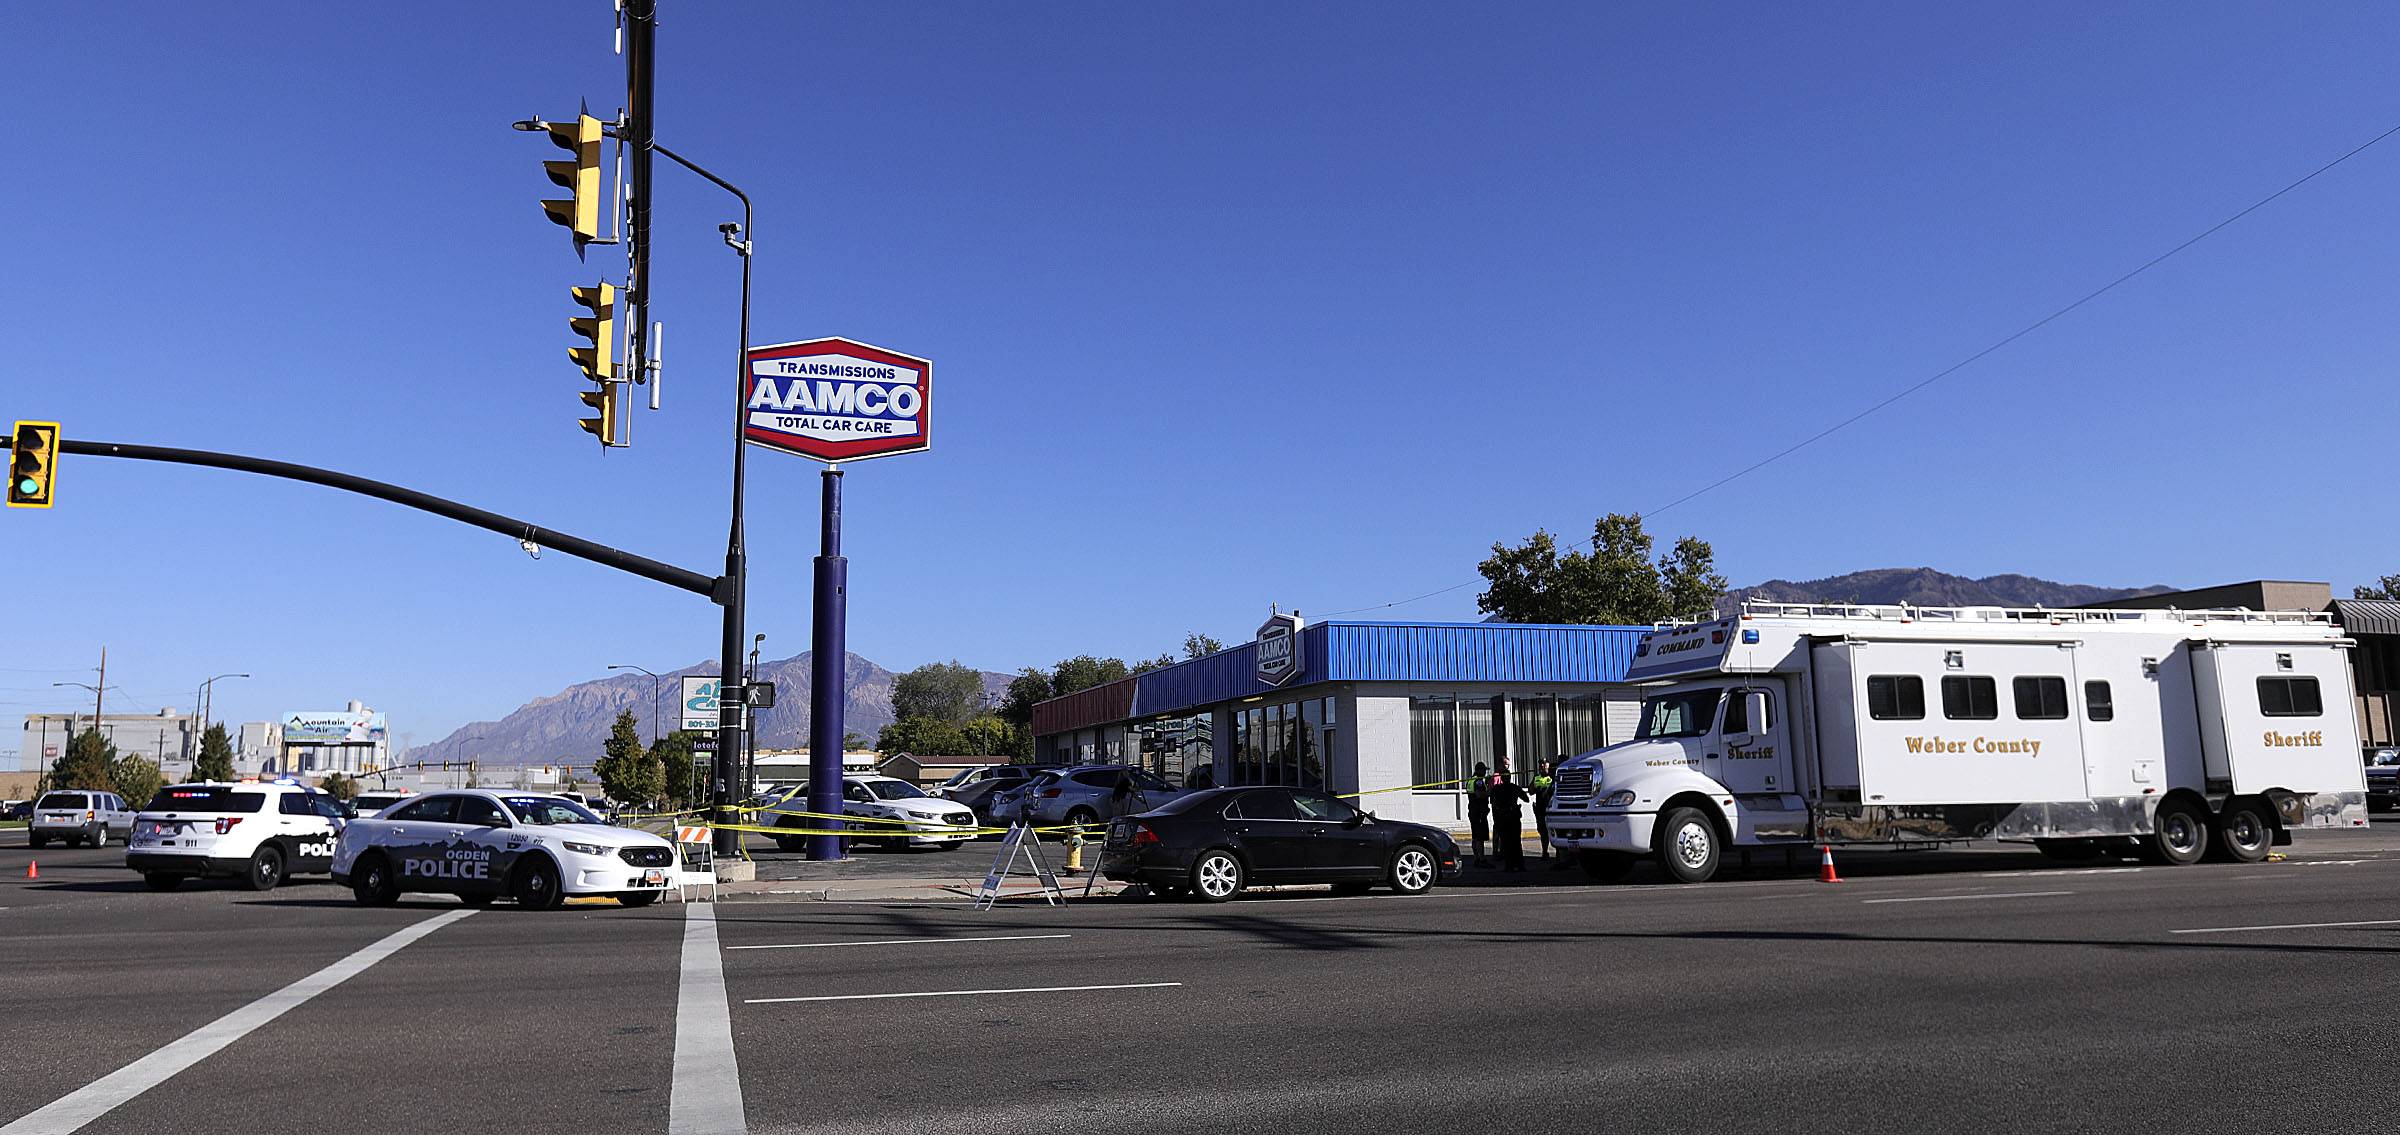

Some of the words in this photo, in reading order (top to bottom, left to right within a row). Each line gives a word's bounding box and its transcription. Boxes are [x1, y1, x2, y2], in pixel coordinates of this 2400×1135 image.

[778, 361, 896, 380] TRANSMISSIONS
[747, 377, 922, 418] AAMCO
[776, 416, 820, 430] TOTAL
[822, 419, 852, 431] CAR
[854, 421, 893, 433] CARE
[1258, 637, 1291, 661] AAMCO
[1657, 637, 1705, 656] COMMAND
[315, 726, 328, 734] Air
[2263, 730, 2323, 747] Sheriff
[1727, 747, 1774, 760] Sheriff
[1905, 736, 1967, 753] Weber
[1973, 736, 2041, 758] County
[1672, 758, 1700, 766] County
[185, 839, 198, 848] 911
[299, 842, 337, 857] POLI
[446, 850, 490, 861] OGDEN
[404, 858, 489, 879] POLICE
